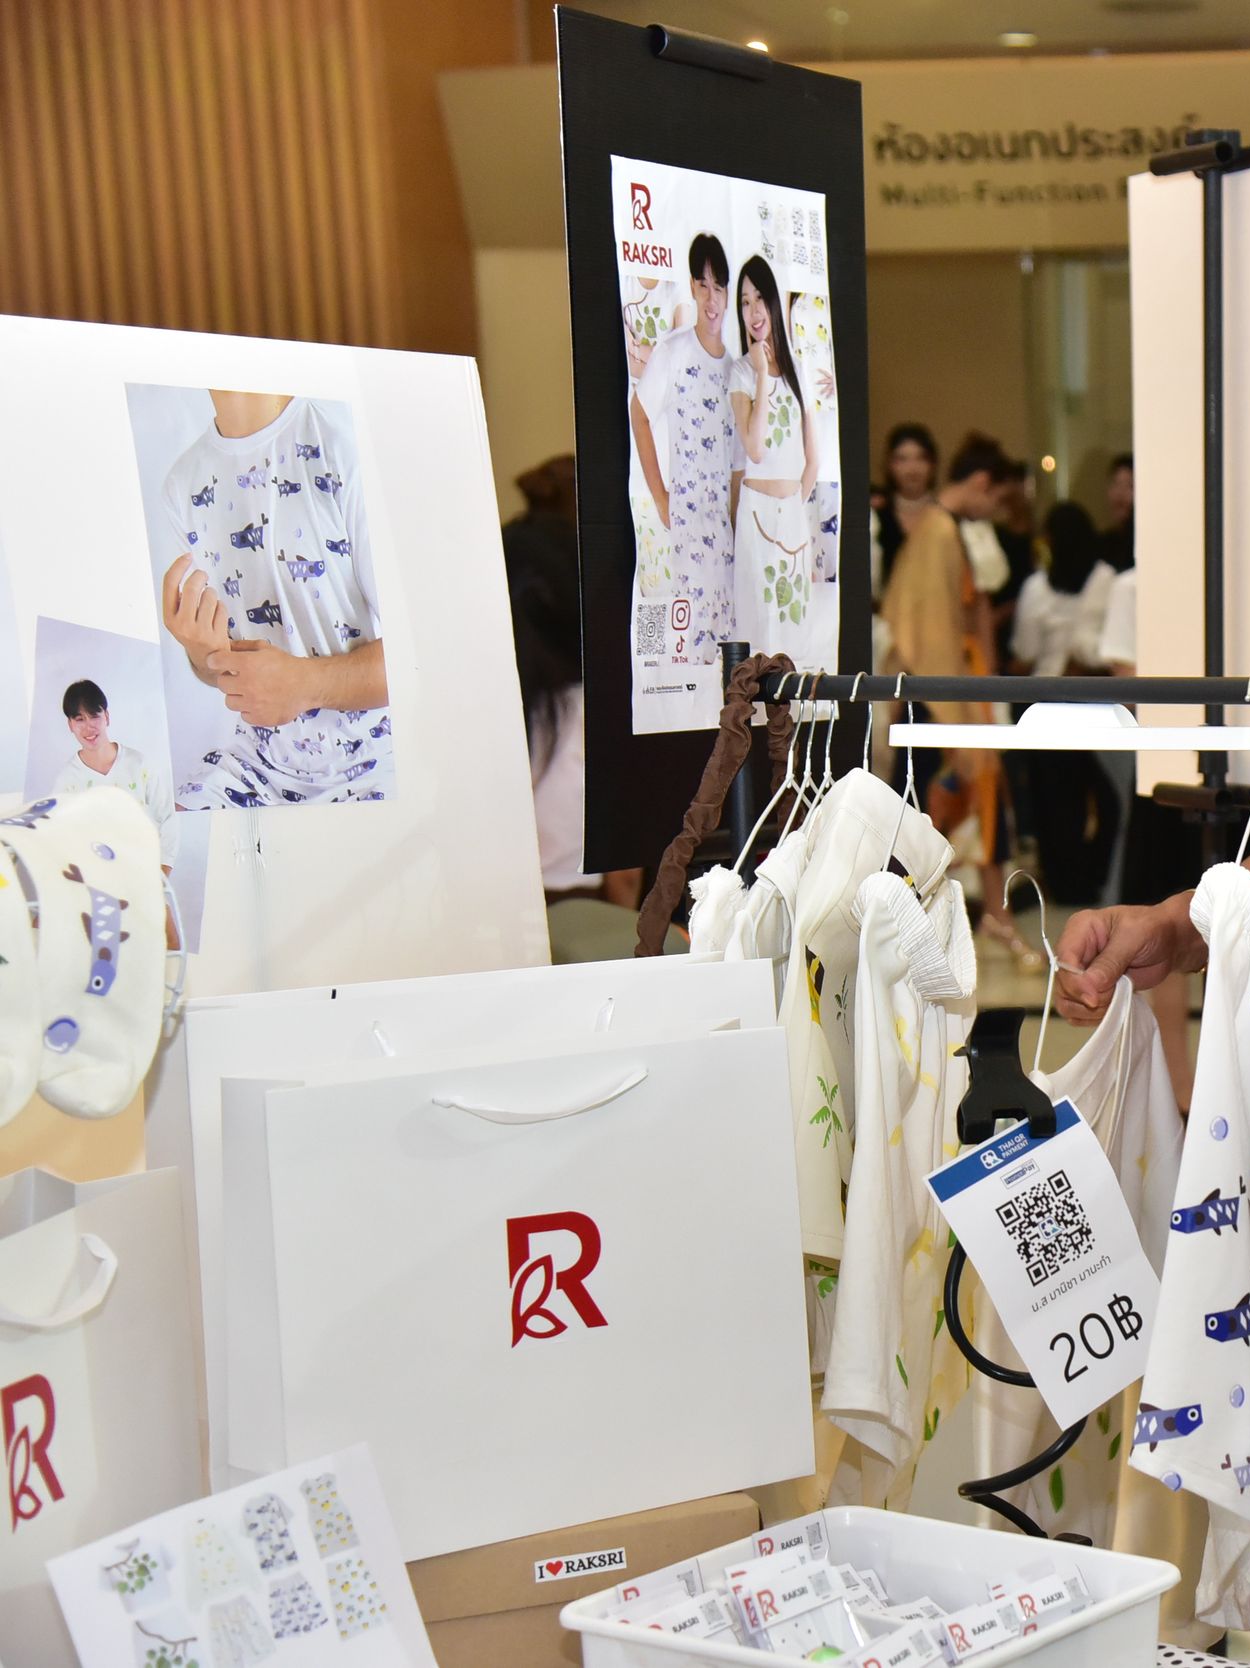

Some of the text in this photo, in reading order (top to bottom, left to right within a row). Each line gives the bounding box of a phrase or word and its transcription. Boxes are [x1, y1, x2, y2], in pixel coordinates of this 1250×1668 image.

[622, 240, 672, 268] RAKSRI
[998, 1133, 1026, 1152] THAI QR
[1001, 1139, 1029, 1158] PAYMENT
[781, 1535, 804, 1550] RAKSRI
[538, 1550, 624, 1579] I RAKSRI
[781, 1586, 808, 1602] RAKSRI
[1041, 1591, 1064, 1606] RAKSRI
[971, 1619, 997, 1636] RAKSRI
